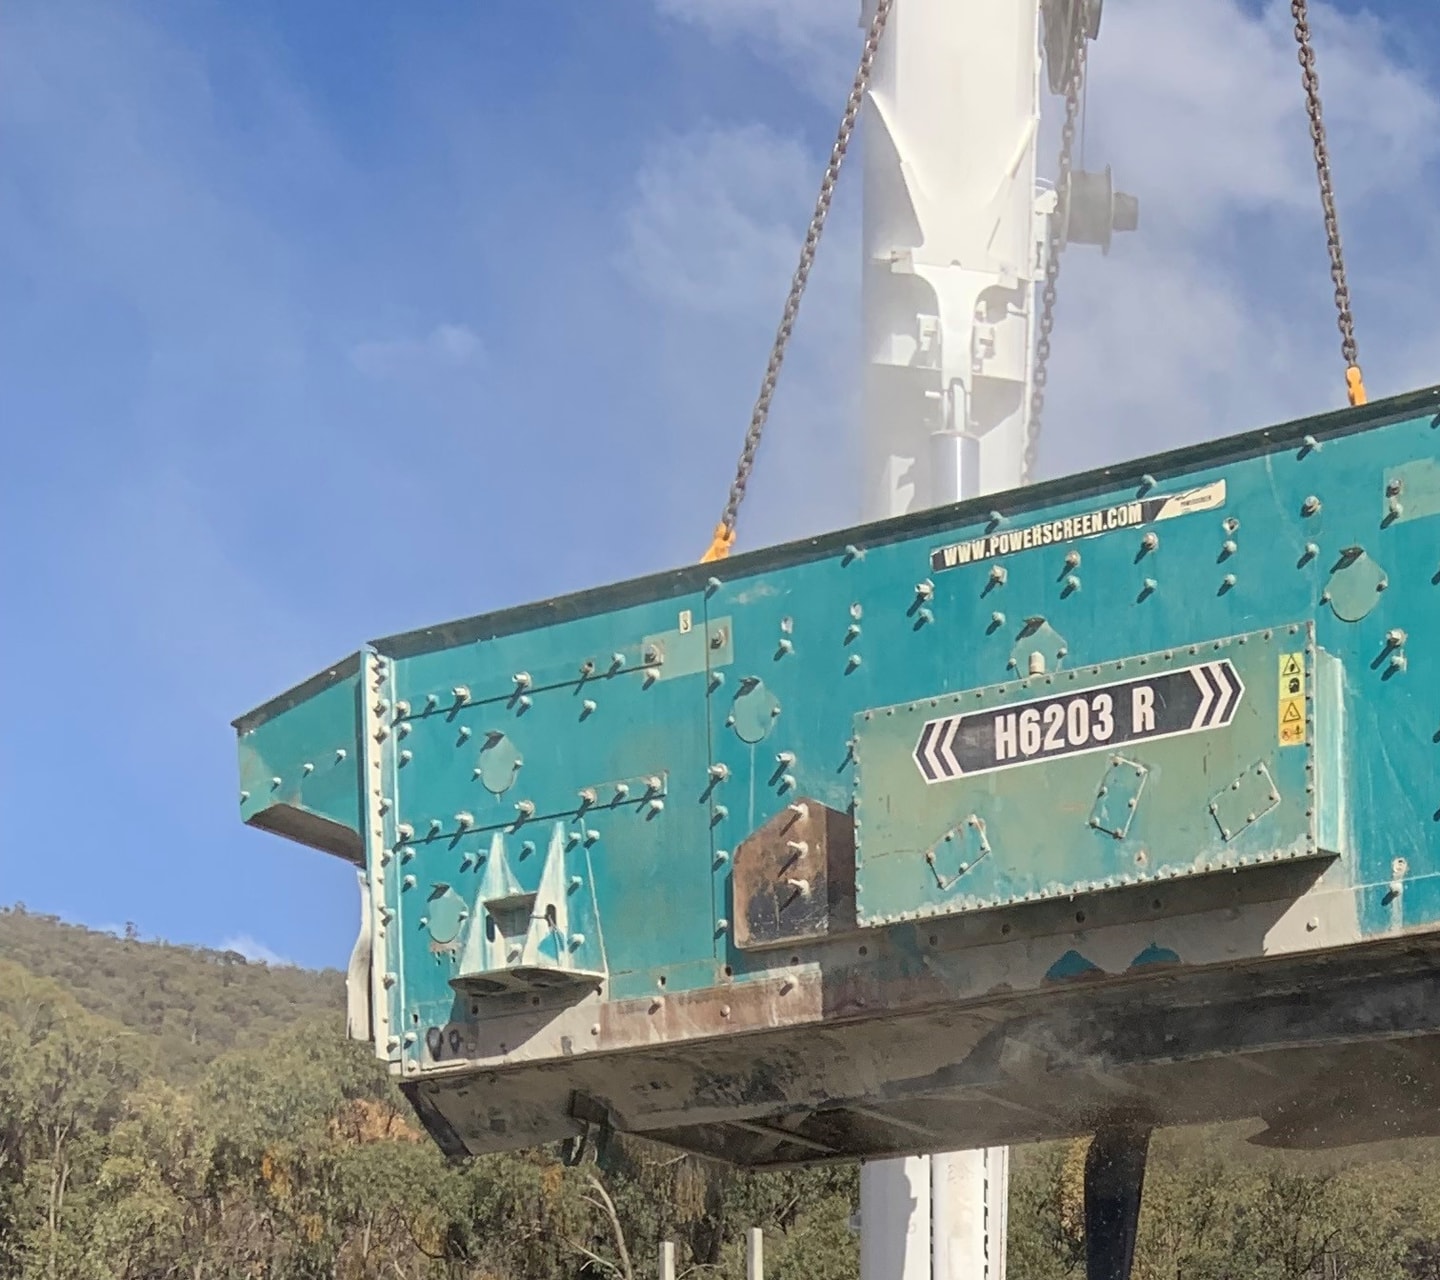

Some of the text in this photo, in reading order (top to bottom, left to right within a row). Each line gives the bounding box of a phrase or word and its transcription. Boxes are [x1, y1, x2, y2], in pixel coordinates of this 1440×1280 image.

[943, 503, 1142, 567] WWW.POWERSCREEN.COM
[994, 685, 1156, 761] H6203 R
